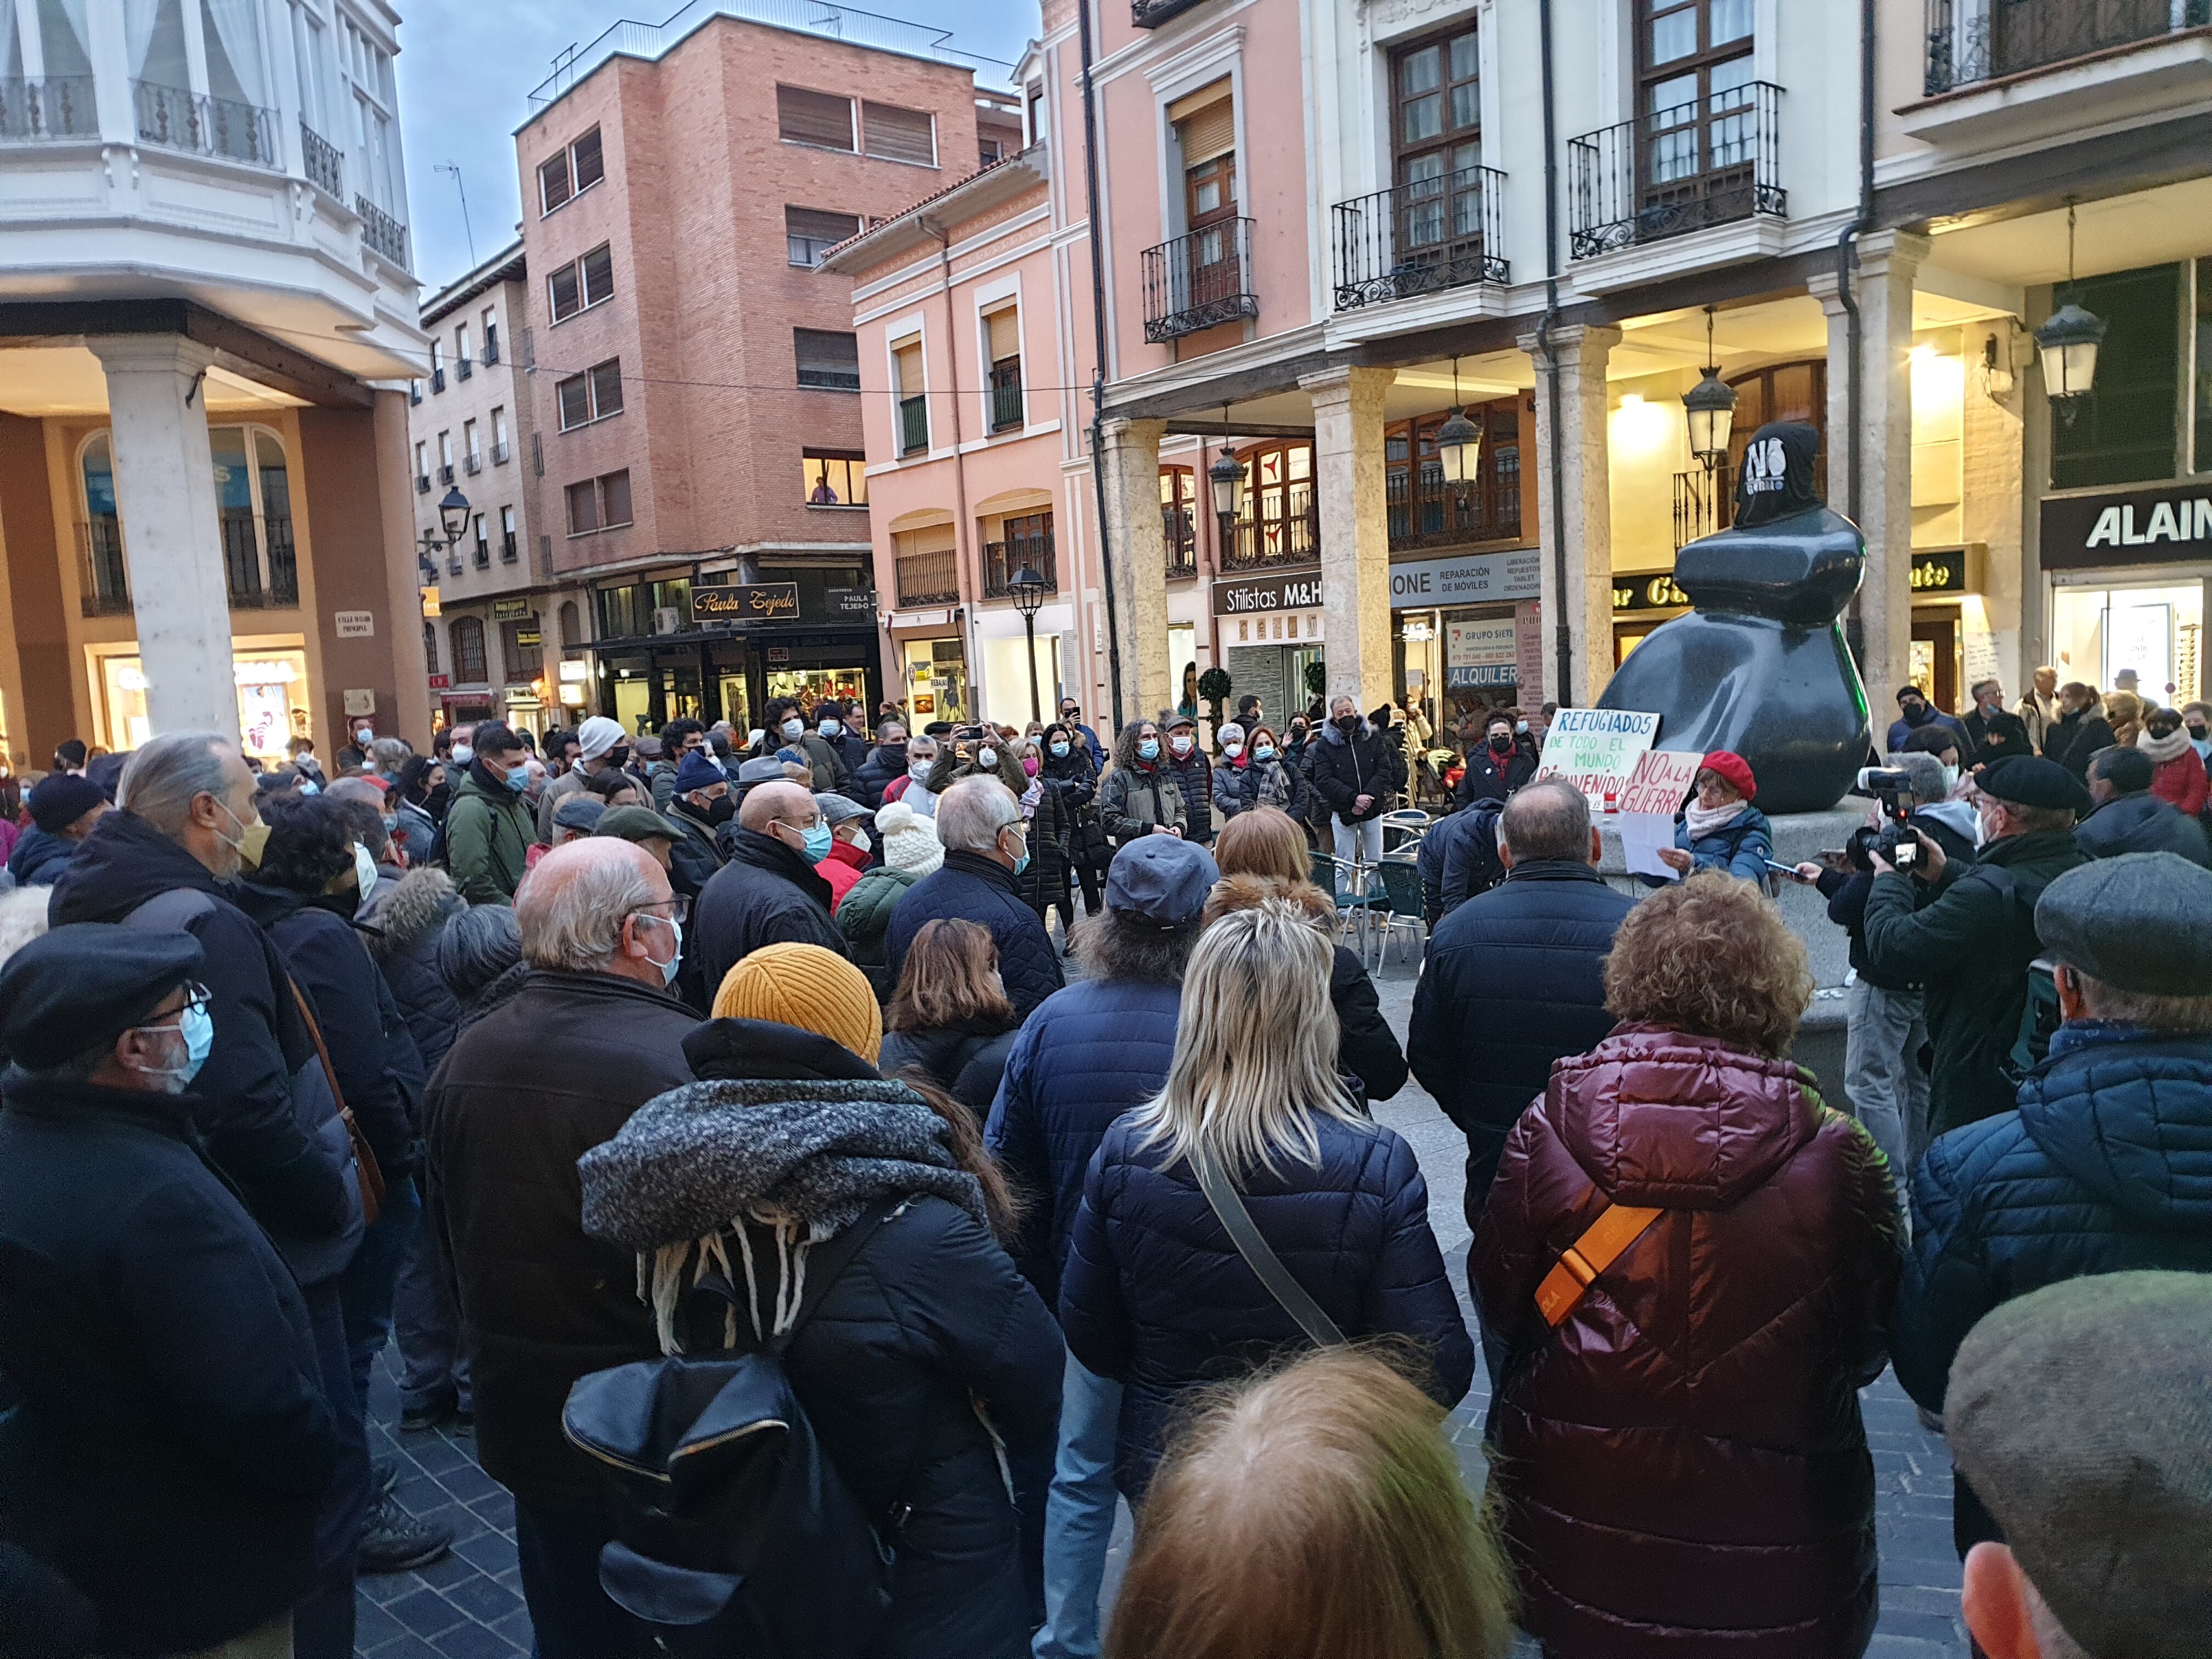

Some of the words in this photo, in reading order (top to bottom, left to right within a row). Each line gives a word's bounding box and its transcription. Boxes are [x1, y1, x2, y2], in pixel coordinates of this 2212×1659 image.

[1746, 437, 1786, 482] NO
[1440, 566, 1490, 580] REPARACIÓN
[1514, 574, 1535, 582] TABLET
[1389, 572, 1431, 596] ONE
[1442, 583, 1453, 592] DE
[1454, 579, 1488, 591] MÓVILES
[695, 591, 739, 612] Paula
[749, 590, 795, 616] Tejedo
[1227, 586, 1277, 612] Stilistas
[1283, 580, 1322, 606] M&H
[1465, 631, 1493, 640] GRUPO
[1494, 629, 1514, 639] SIETE
[1451, 665, 1517, 685] ALQUILER
[1550, 736, 1564, 748] DE
[1570, 735, 1598, 750] TODO
[1609, 737, 1626, 751] EL
[1575, 753, 1621, 770] MUNDO
[1632, 749, 1670, 786] NO
[1663, 766, 1671, 780] A
[1674, 765, 1692, 785] LA
[1621, 784, 1683, 815] GUERRA
